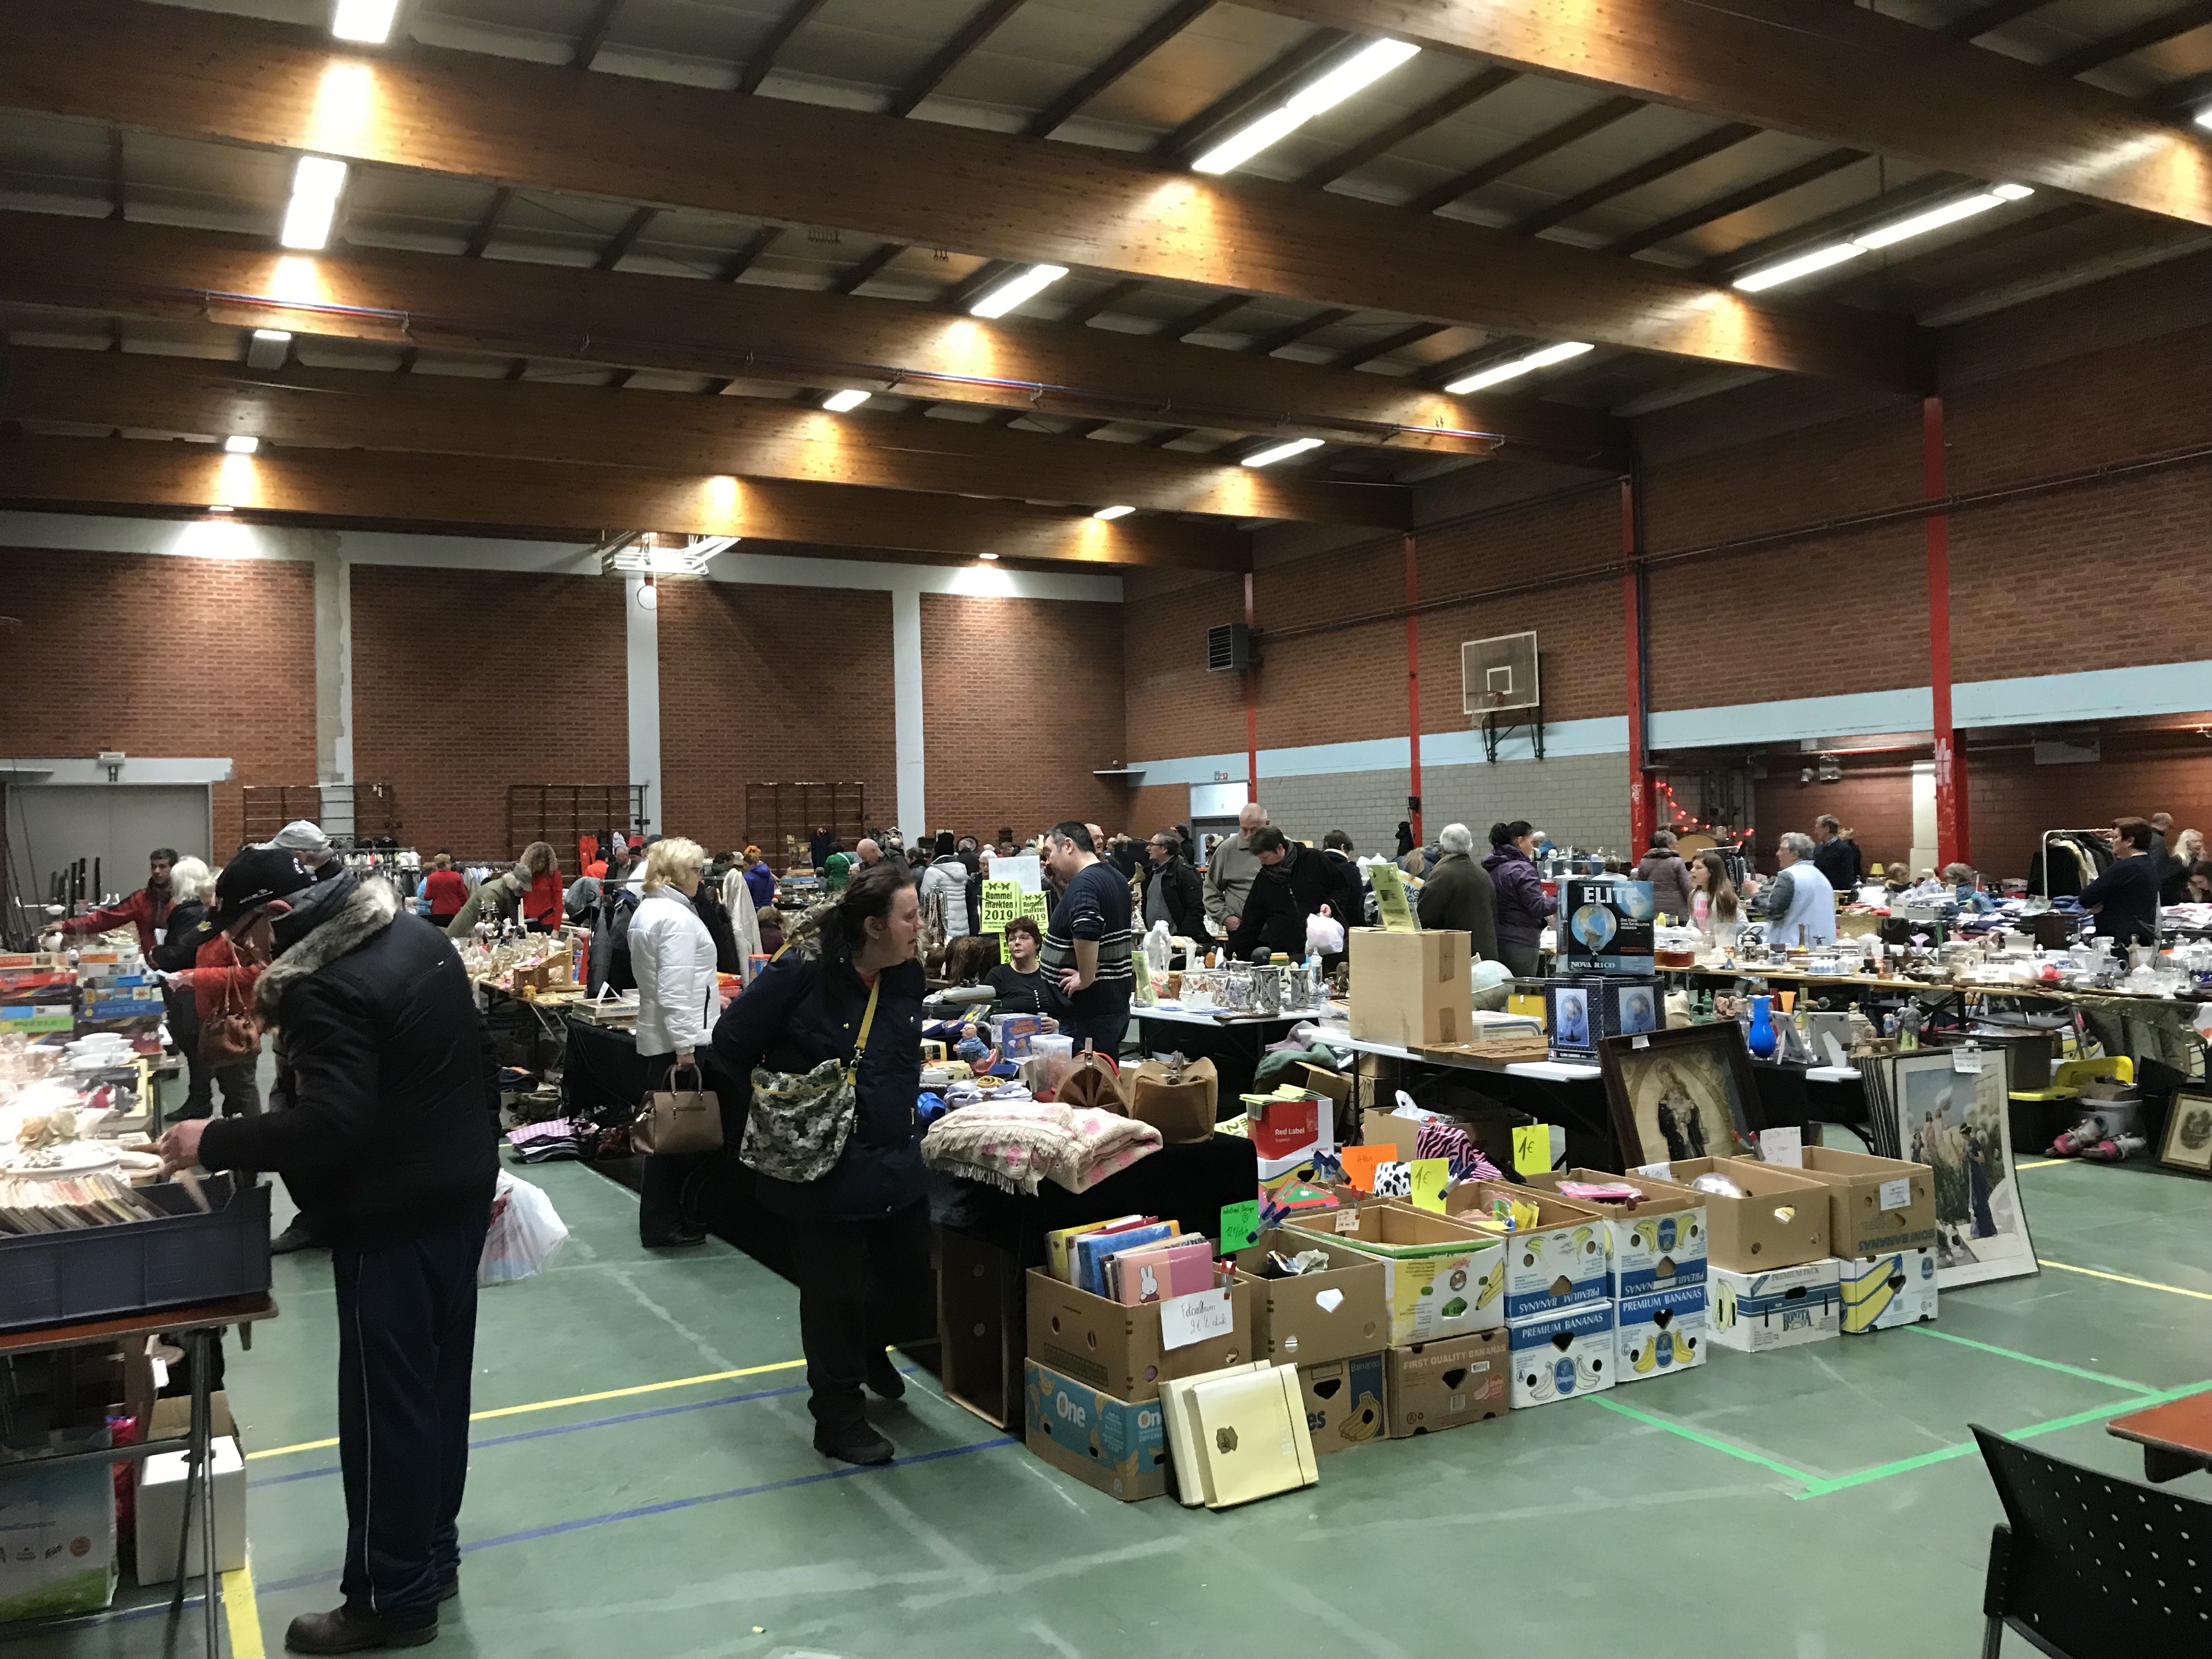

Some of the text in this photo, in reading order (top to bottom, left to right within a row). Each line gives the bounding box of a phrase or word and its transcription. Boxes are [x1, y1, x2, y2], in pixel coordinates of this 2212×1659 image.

[985, 891, 1012, 900] Rommel
[985, 900, 1013, 909] markten
[1583, 887, 1638, 904] ELITE
[984, 910, 1013, 920] 2019
[1288, 1127, 1305, 1135] Label
[1518, 1136, 1536, 1161] 1€
[1415, 1166, 1431, 1190] 1€
[1625, 1272, 1705, 1295] PREMIU NANAS
[1771, 1268, 1802, 1282] PREMIUM
[1519, 1286, 1600, 1313] PREMIUM BANANAS
[1622, 1288, 1702, 1312] PREMIUM BANANAS
[1522, 1312, 1604, 1339] PREMIUM BANANAS
[1350, 1359, 1380, 1372] Bananas
[1403, 1344, 1506, 1370] FIRST QUALITY BANANAS
[1056, 1390, 1086, 1427] One
[1137, 1409, 1162, 1429] On
